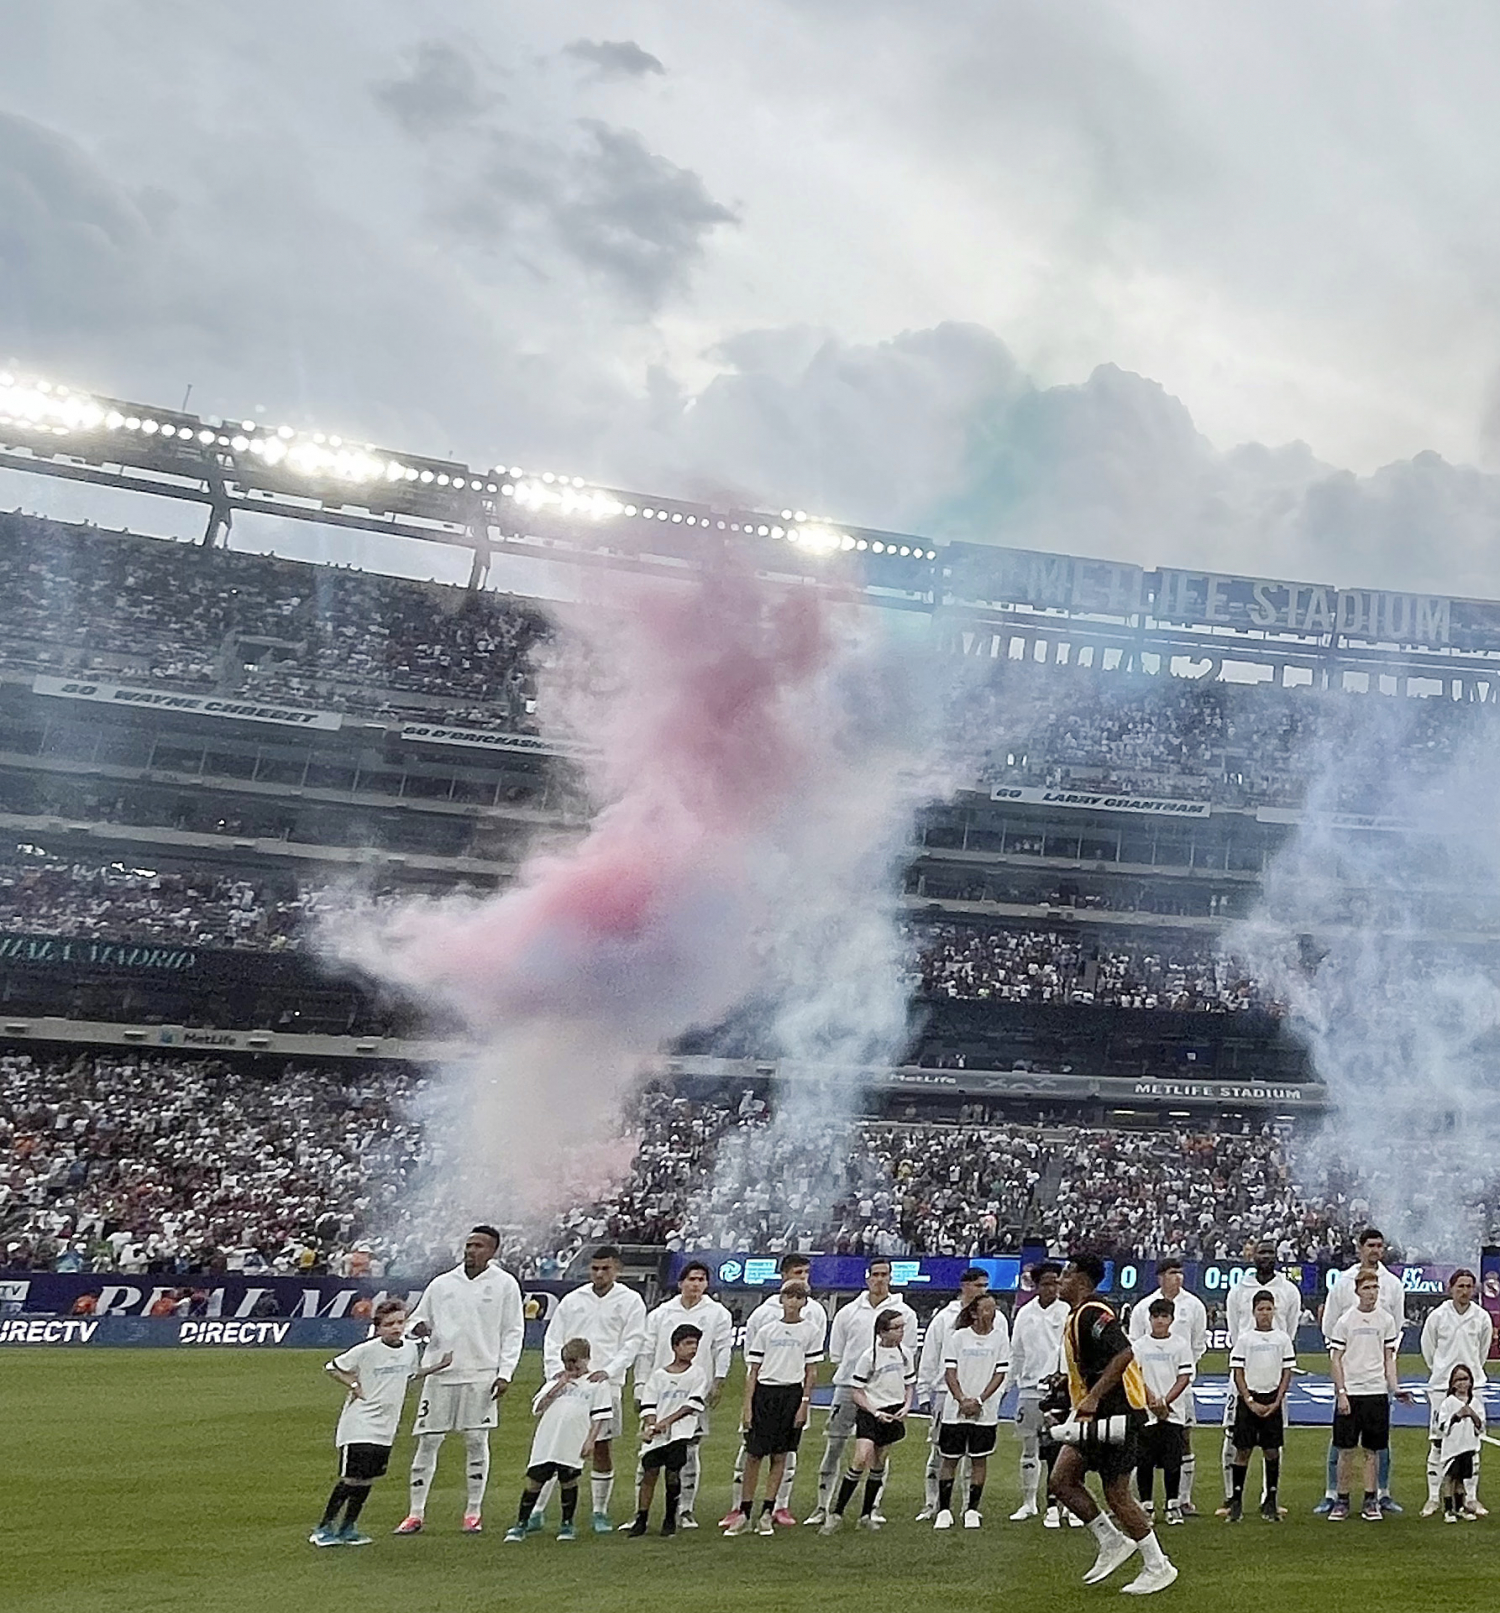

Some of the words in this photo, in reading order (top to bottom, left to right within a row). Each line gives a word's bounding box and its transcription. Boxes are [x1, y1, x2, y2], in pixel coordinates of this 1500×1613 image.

[1027, 558, 1231, 622] METLIFE
[1249, 581, 1451, 642] STADIUM
[114, 690, 203, 709] WAYNE
[1042, 793, 1103, 804] LARRY
[1103, 798, 1205, 813] GRANTHAM
[183, 1032, 237, 1046] MetLife
[1134, 1083, 1214, 1096] METLIFE
[1220, 1086, 1302, 1099] STADIUM
[0, 1320, 99, 1343] IRECTV
[179, 1321, 290, 1344] DIRECTV
